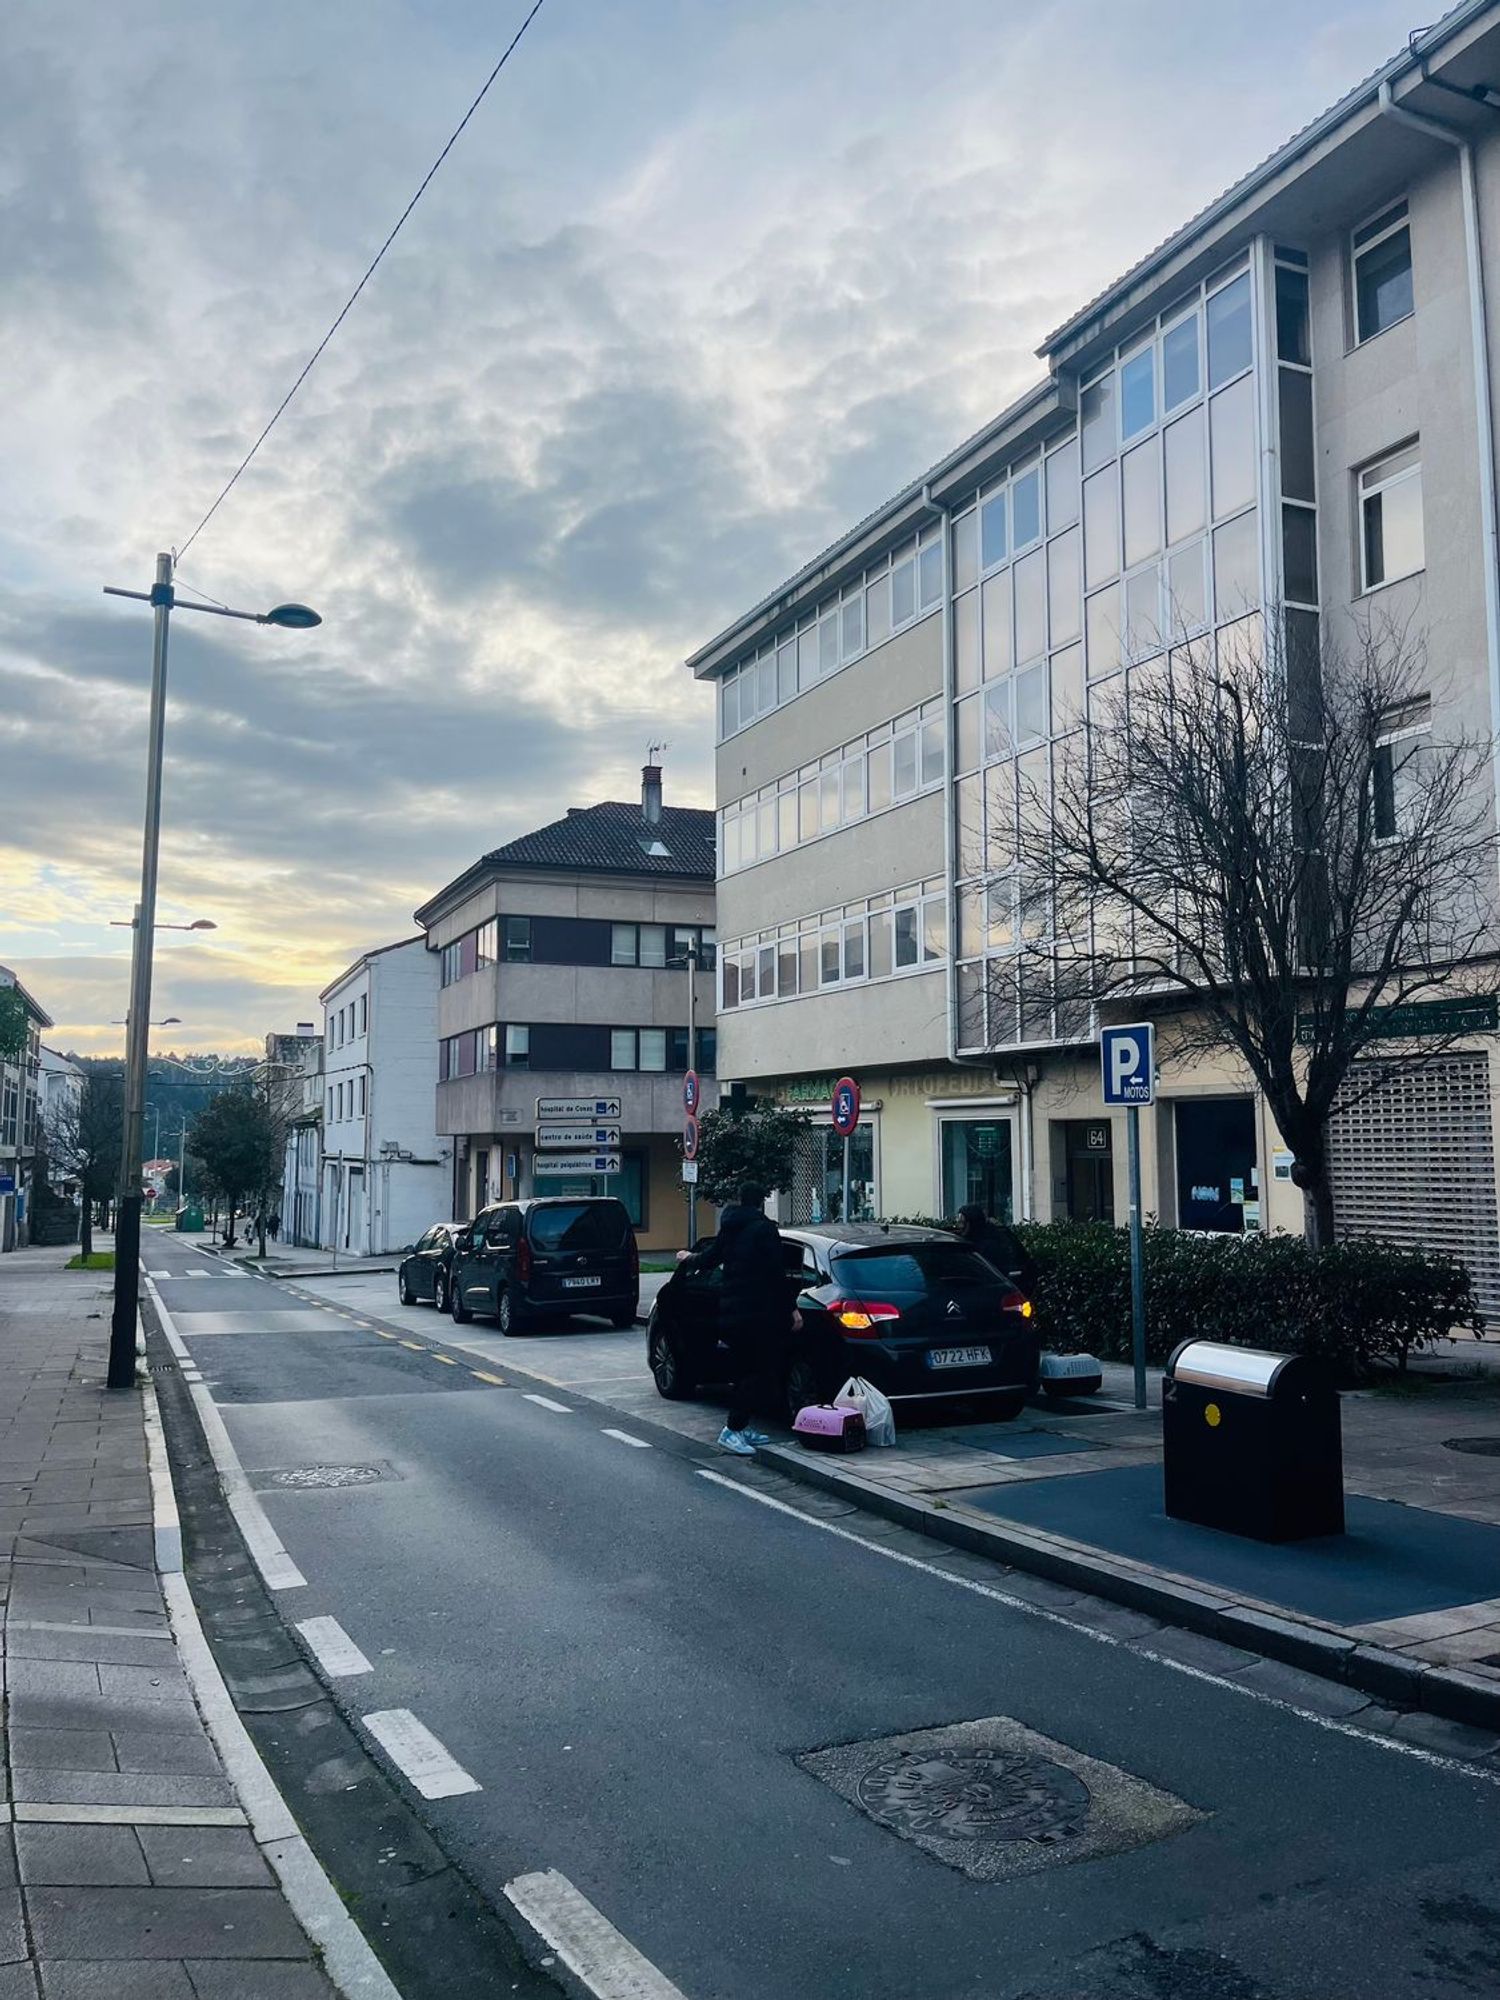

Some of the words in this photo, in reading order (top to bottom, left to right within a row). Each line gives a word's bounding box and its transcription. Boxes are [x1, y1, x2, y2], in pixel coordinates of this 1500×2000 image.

[1110, 1037, 1140, 1095] P
[1123, 1086, 1150, 1099] MOTOS
[1090, 1130, 1104, 1146] 64
[933, 1350, 964, 1364] 0722
[967, 1347, 988, 1361] HFK
